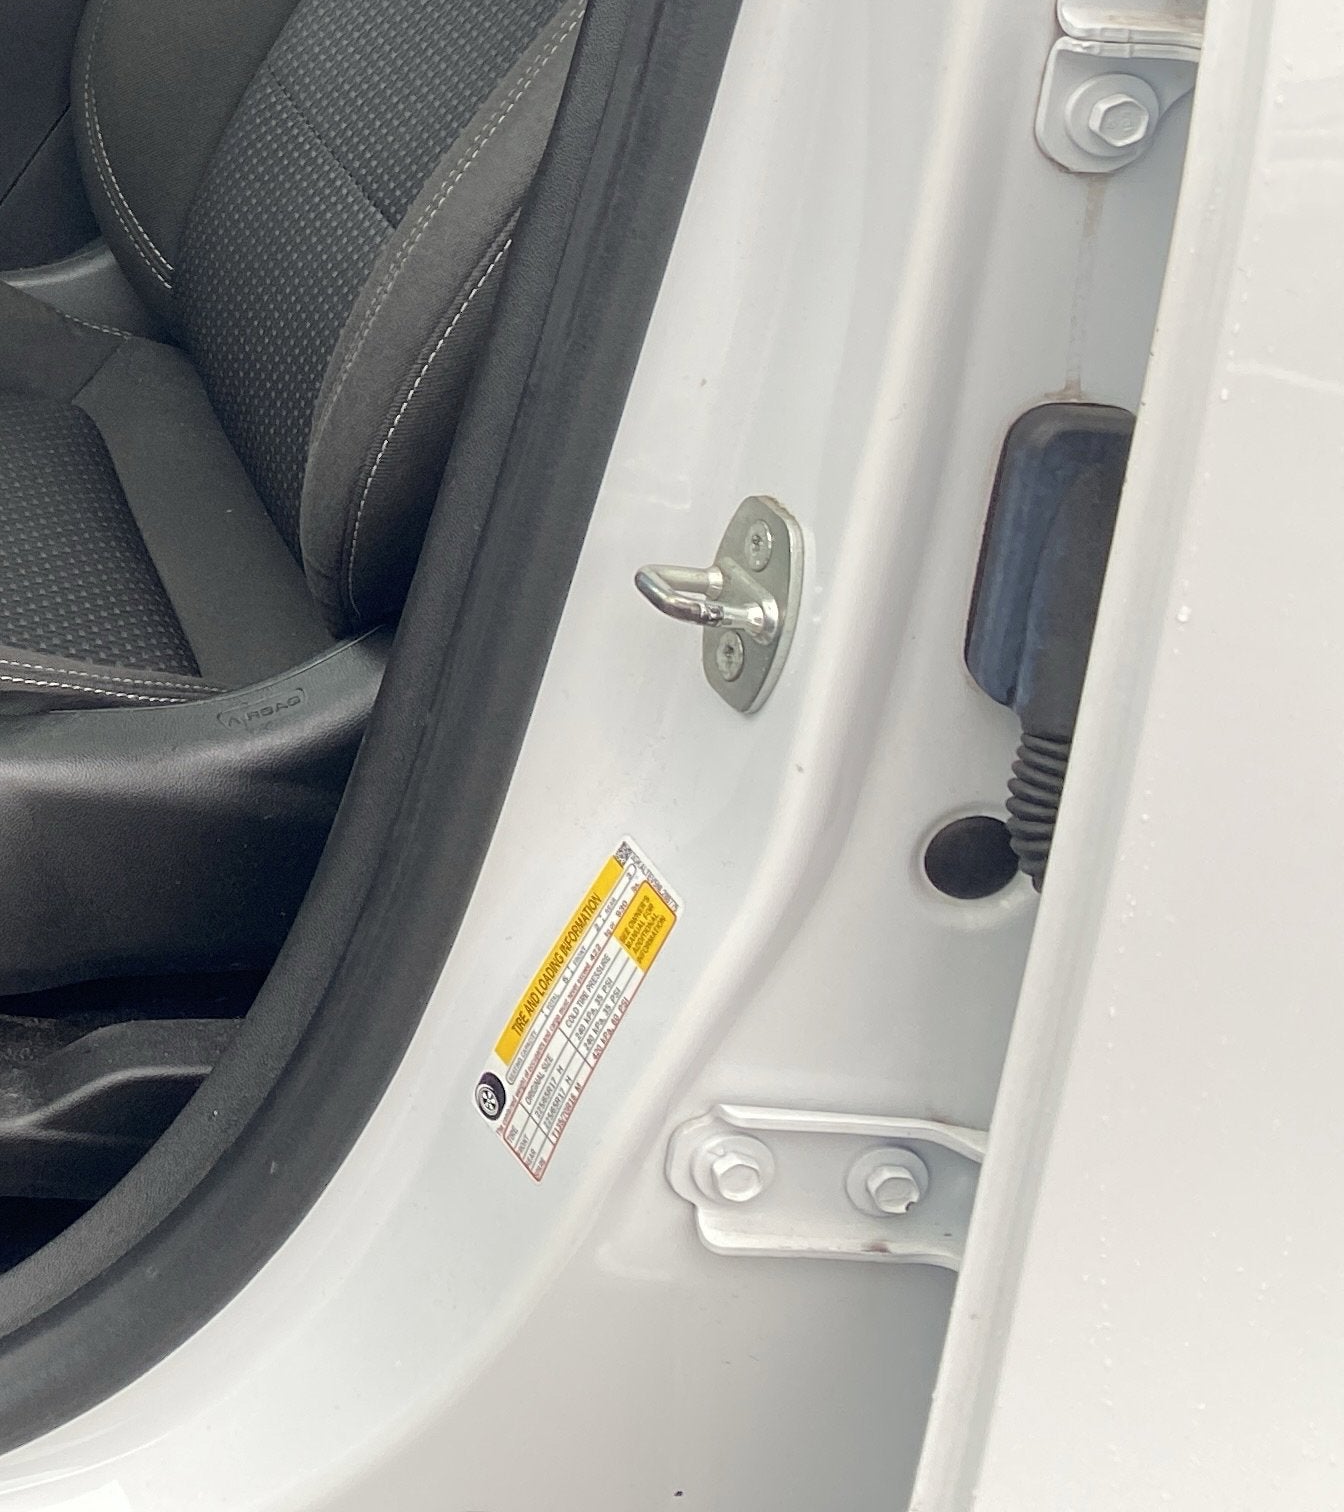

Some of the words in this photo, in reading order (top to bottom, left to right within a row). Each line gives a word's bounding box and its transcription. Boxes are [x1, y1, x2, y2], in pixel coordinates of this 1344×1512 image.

[511, 1011, 529, 1037] TIRE
[524, 991, 540, 1015] AND
[534, 952, 564, 997] LOADING
[559, 893, 600, 956] INFORMATION
